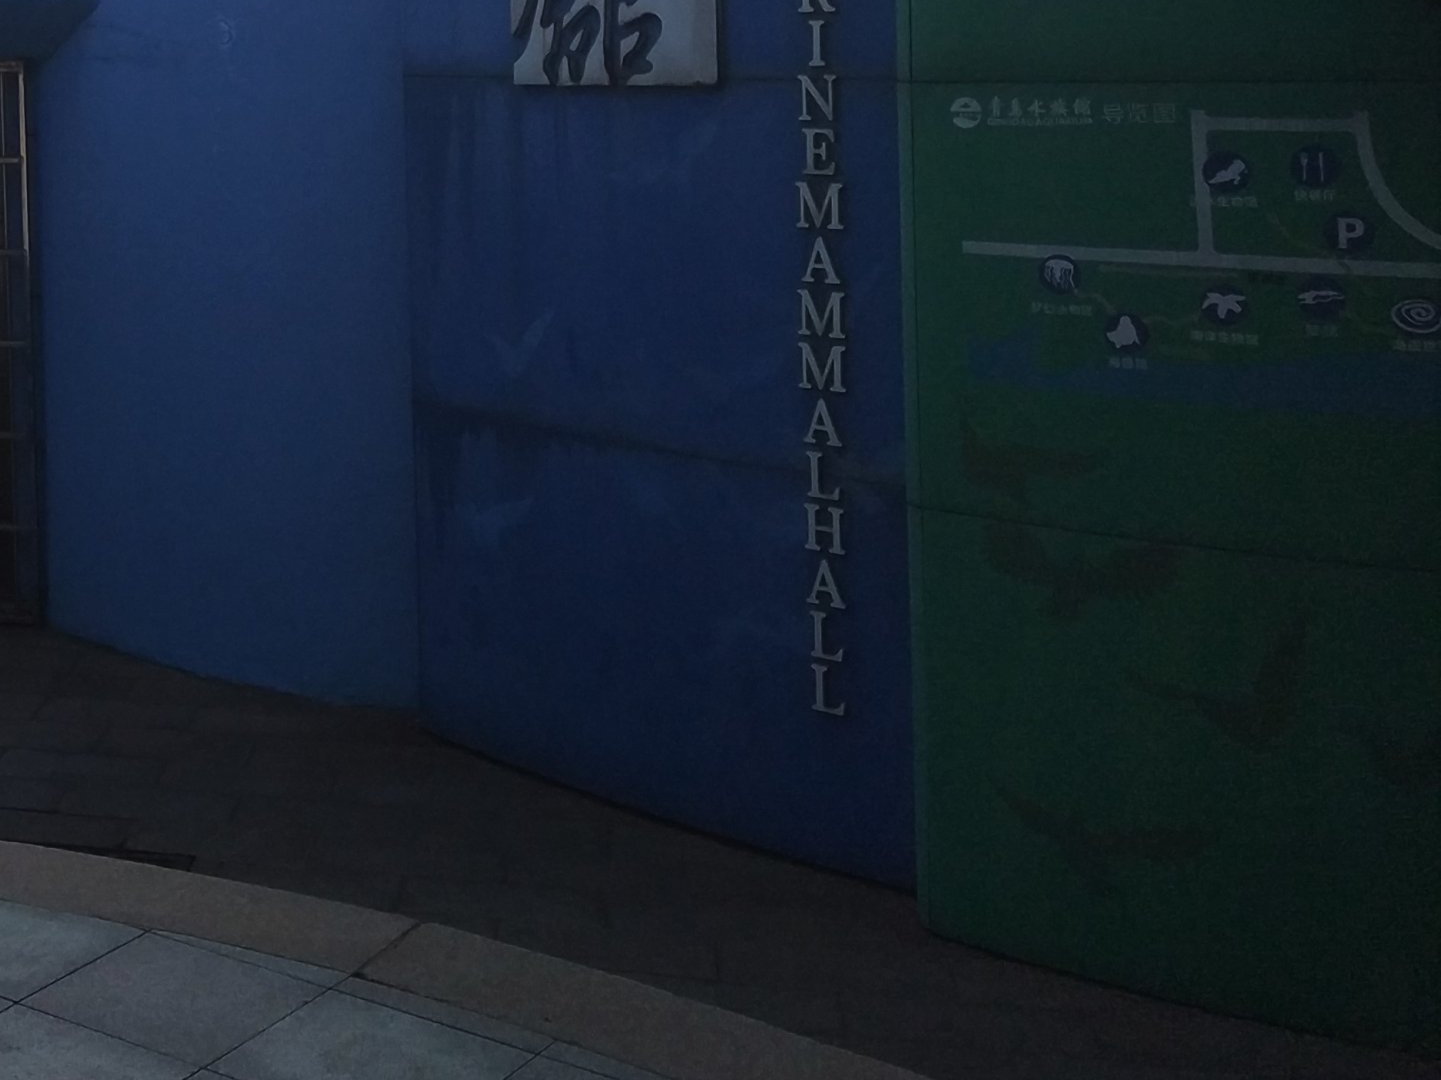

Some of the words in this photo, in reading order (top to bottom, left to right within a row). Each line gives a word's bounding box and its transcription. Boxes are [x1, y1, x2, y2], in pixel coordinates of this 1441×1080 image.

[1100, 102, 1177, 125] 导览图
[1336, 217, 1365, 250] P
